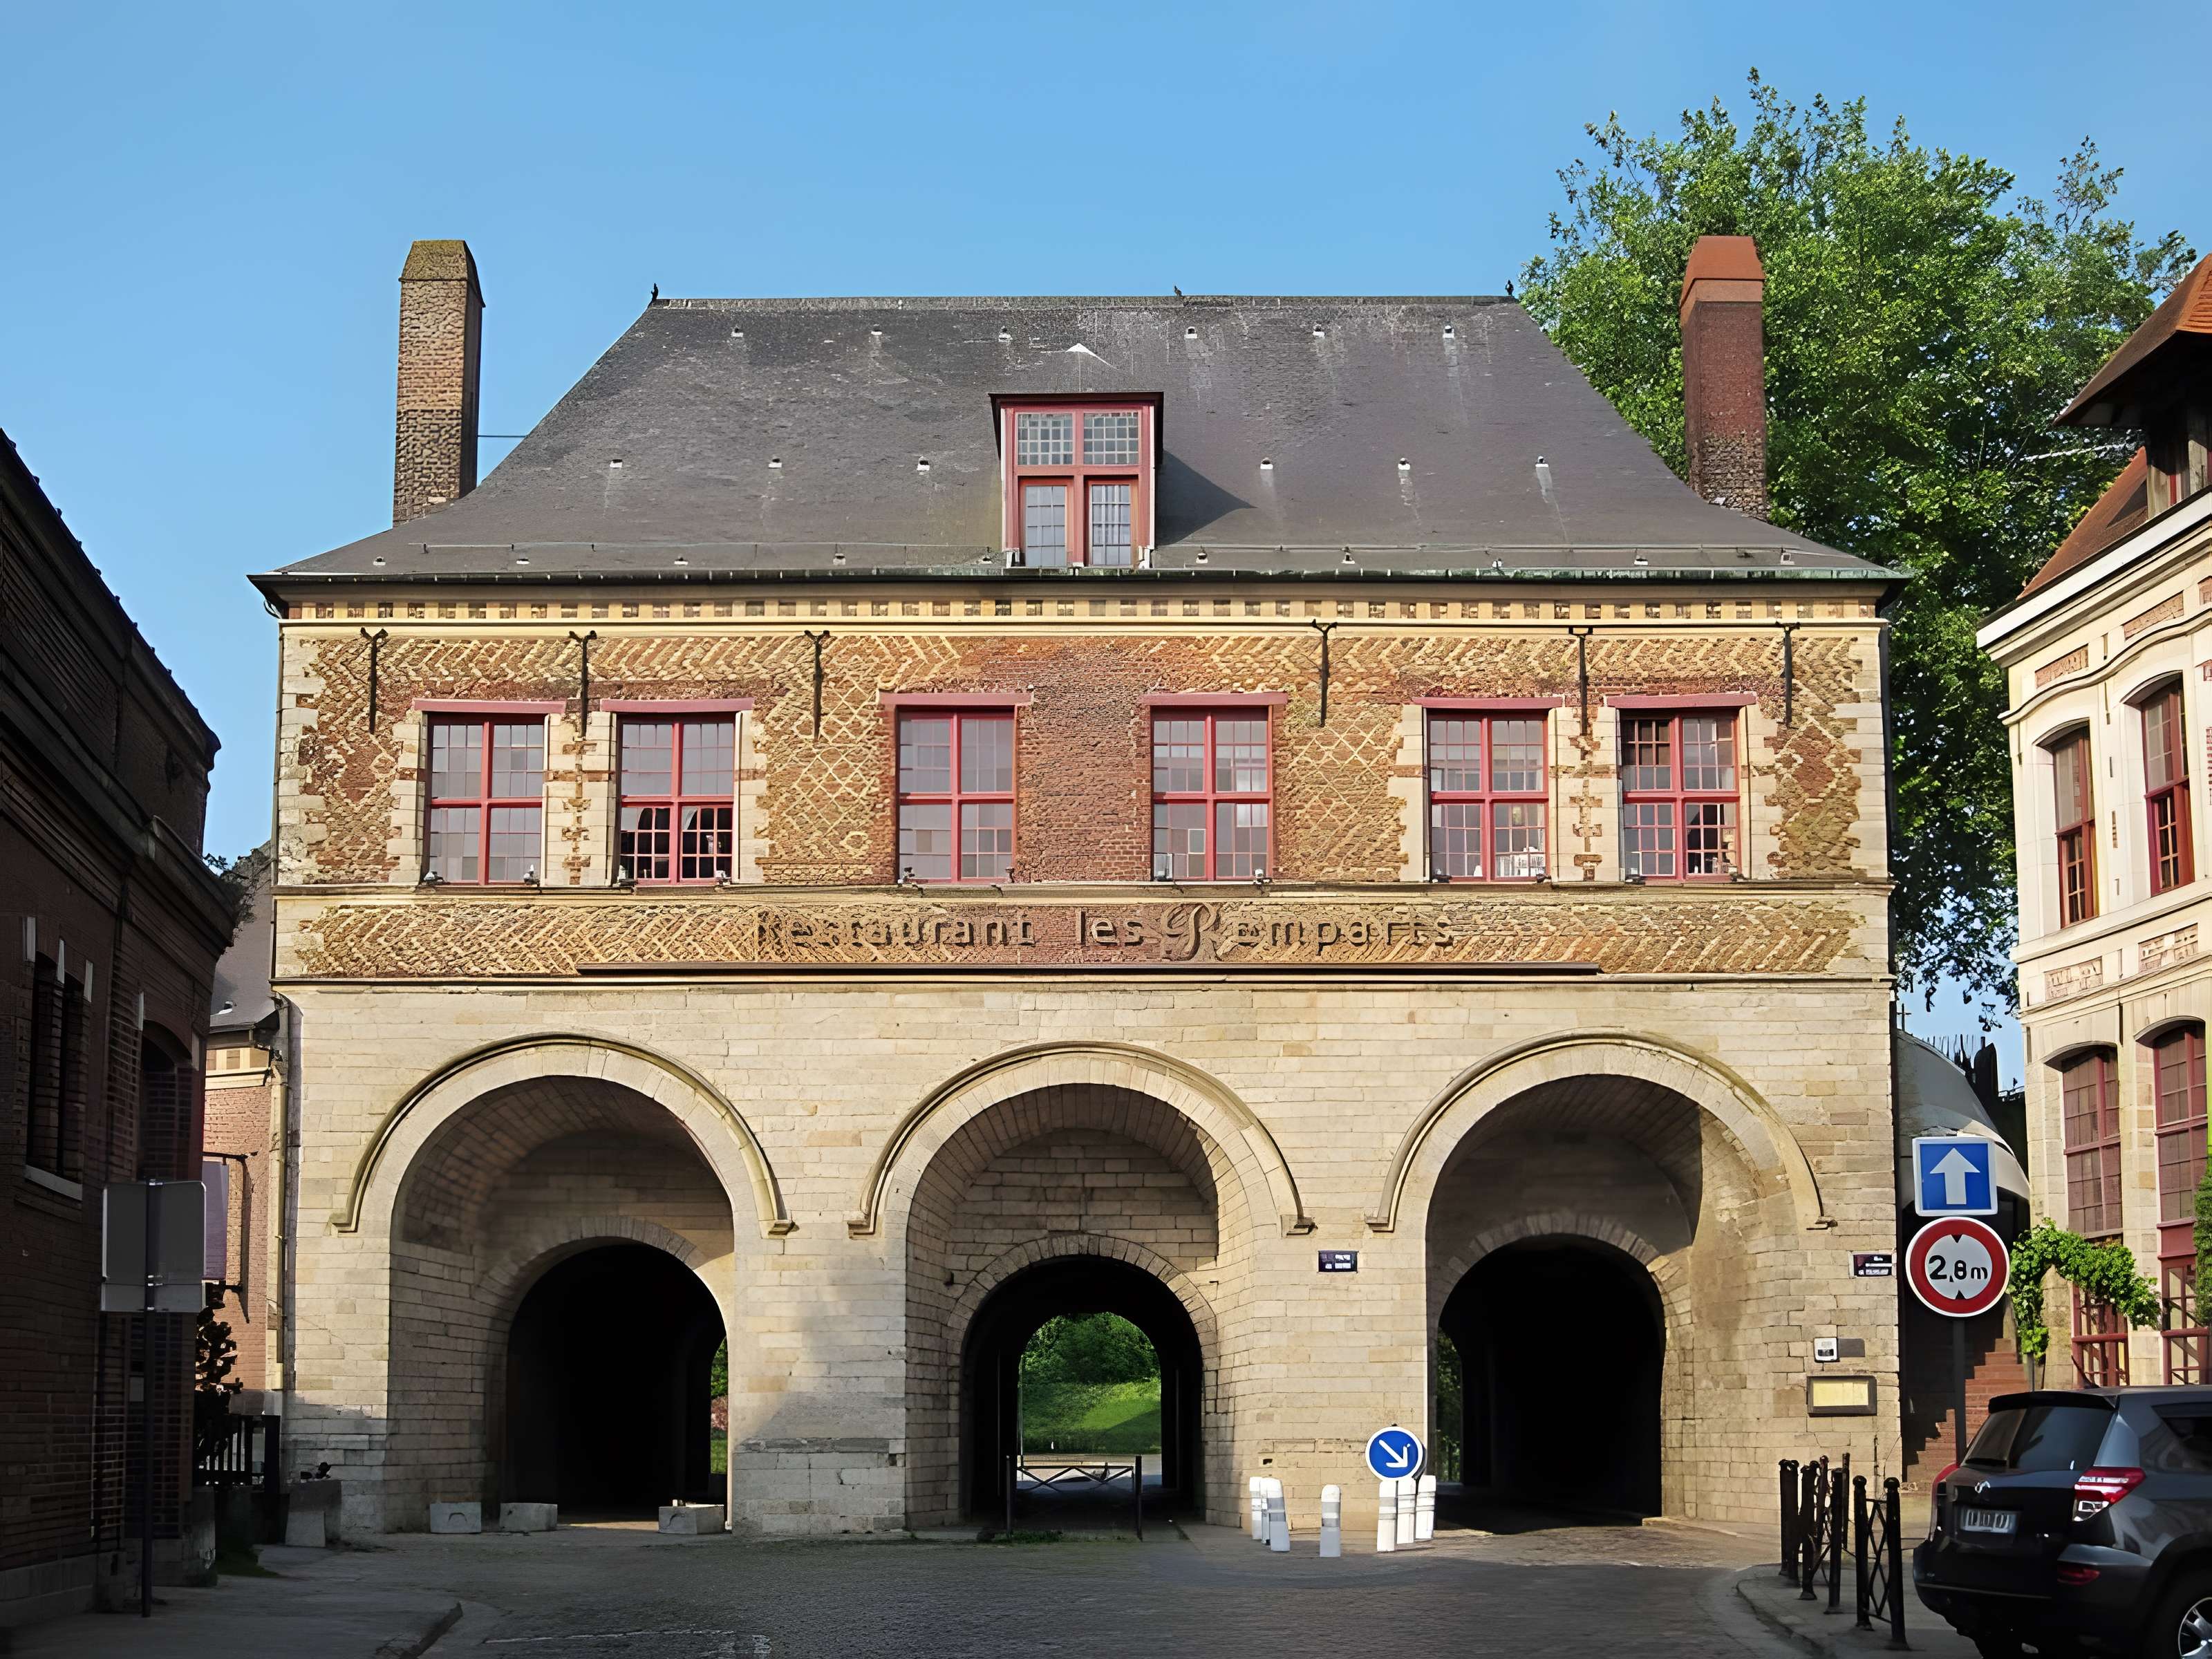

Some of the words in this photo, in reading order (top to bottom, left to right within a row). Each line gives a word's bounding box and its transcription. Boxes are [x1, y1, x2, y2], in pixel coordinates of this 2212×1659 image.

[757, 908, 1036, 948] Restaurant
[1076, 910, 1145, 948] les
[1160, 901, 1454, 962] Remparts
